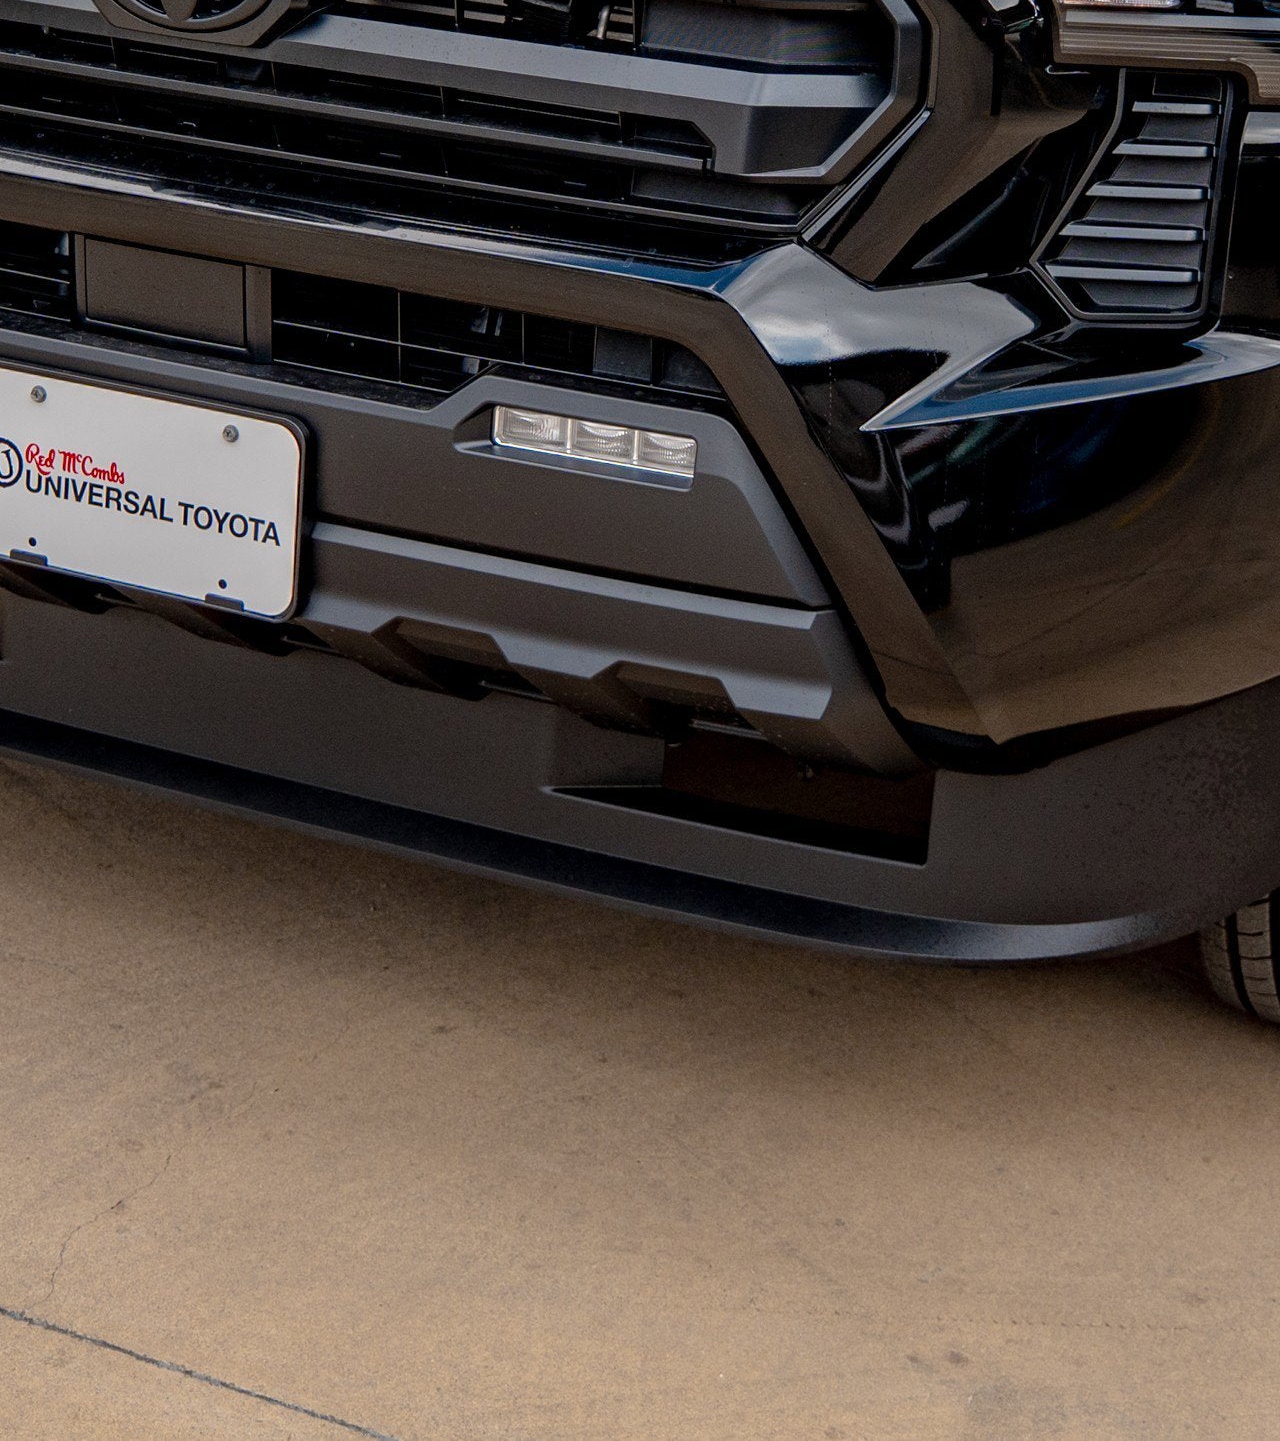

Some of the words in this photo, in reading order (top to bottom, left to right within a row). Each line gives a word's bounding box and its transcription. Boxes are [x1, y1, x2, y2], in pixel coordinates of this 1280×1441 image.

[25, 443, 56, 476] Red
[58, 449, 125, 484] McCombs
[25, 469, 174, 523] UNIVERSAL
[178, 501, 281, 547] TOYOTA
